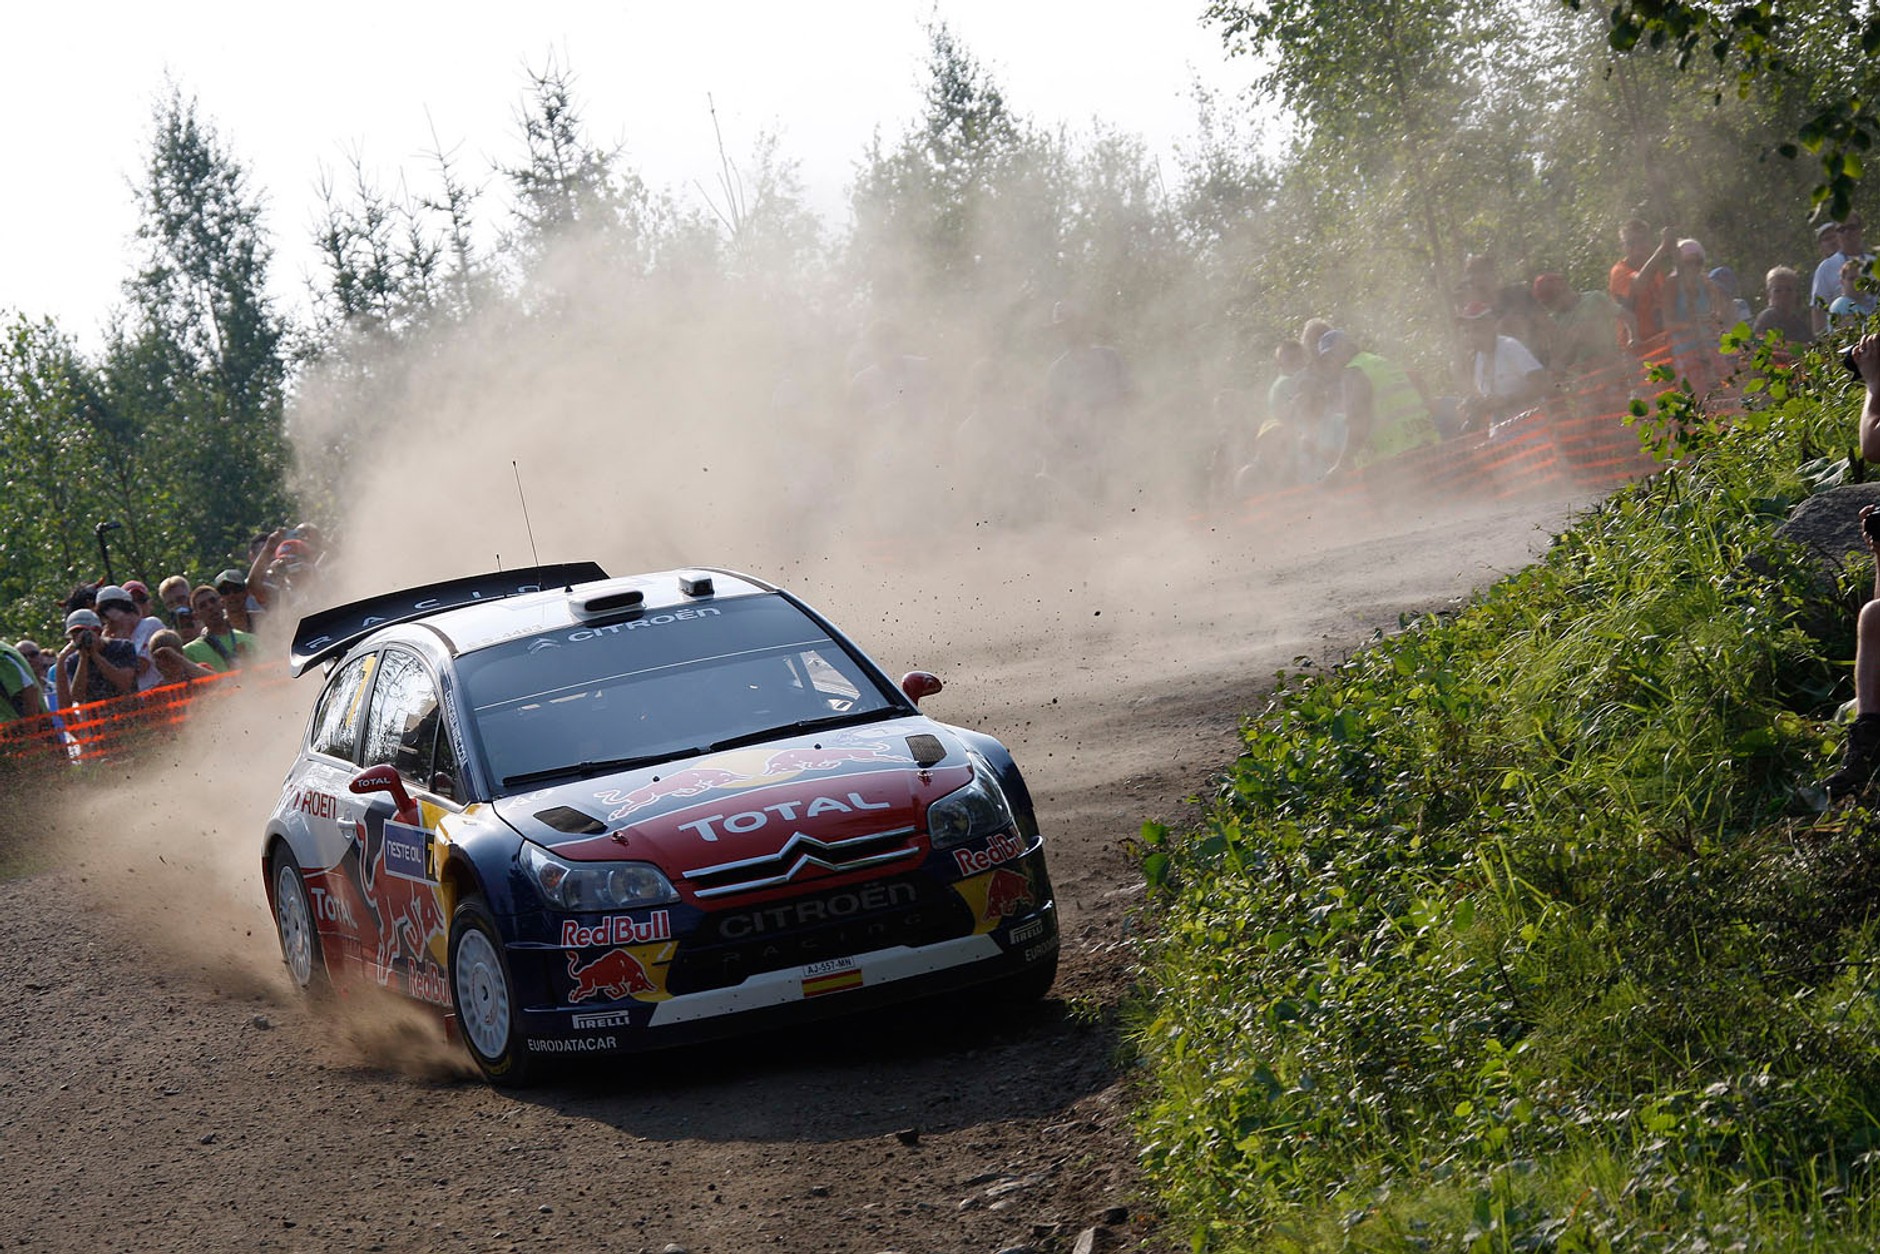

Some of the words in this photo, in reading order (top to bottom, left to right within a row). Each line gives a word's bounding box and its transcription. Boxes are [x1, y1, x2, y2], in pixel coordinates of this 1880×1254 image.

[357, 776, 391, 788] TOTAL
[677, 792, 891, 842] TOTAL
[953, 835, 1006, 877] Red
[311, 887, 358, 930] TOTAL
[560, 915, 612, 948] Red
[612, 909, 671, 944] Bull
[1009, 919, 1043, 945] PIRELLI
[408, 956, 432, 1001] Red
[807, 958, 852, 975] AJ-557-MN
[572, 1009, 631, 1029] PIRELLI
[527, 1035, 617, 1052] EURODATACAR
